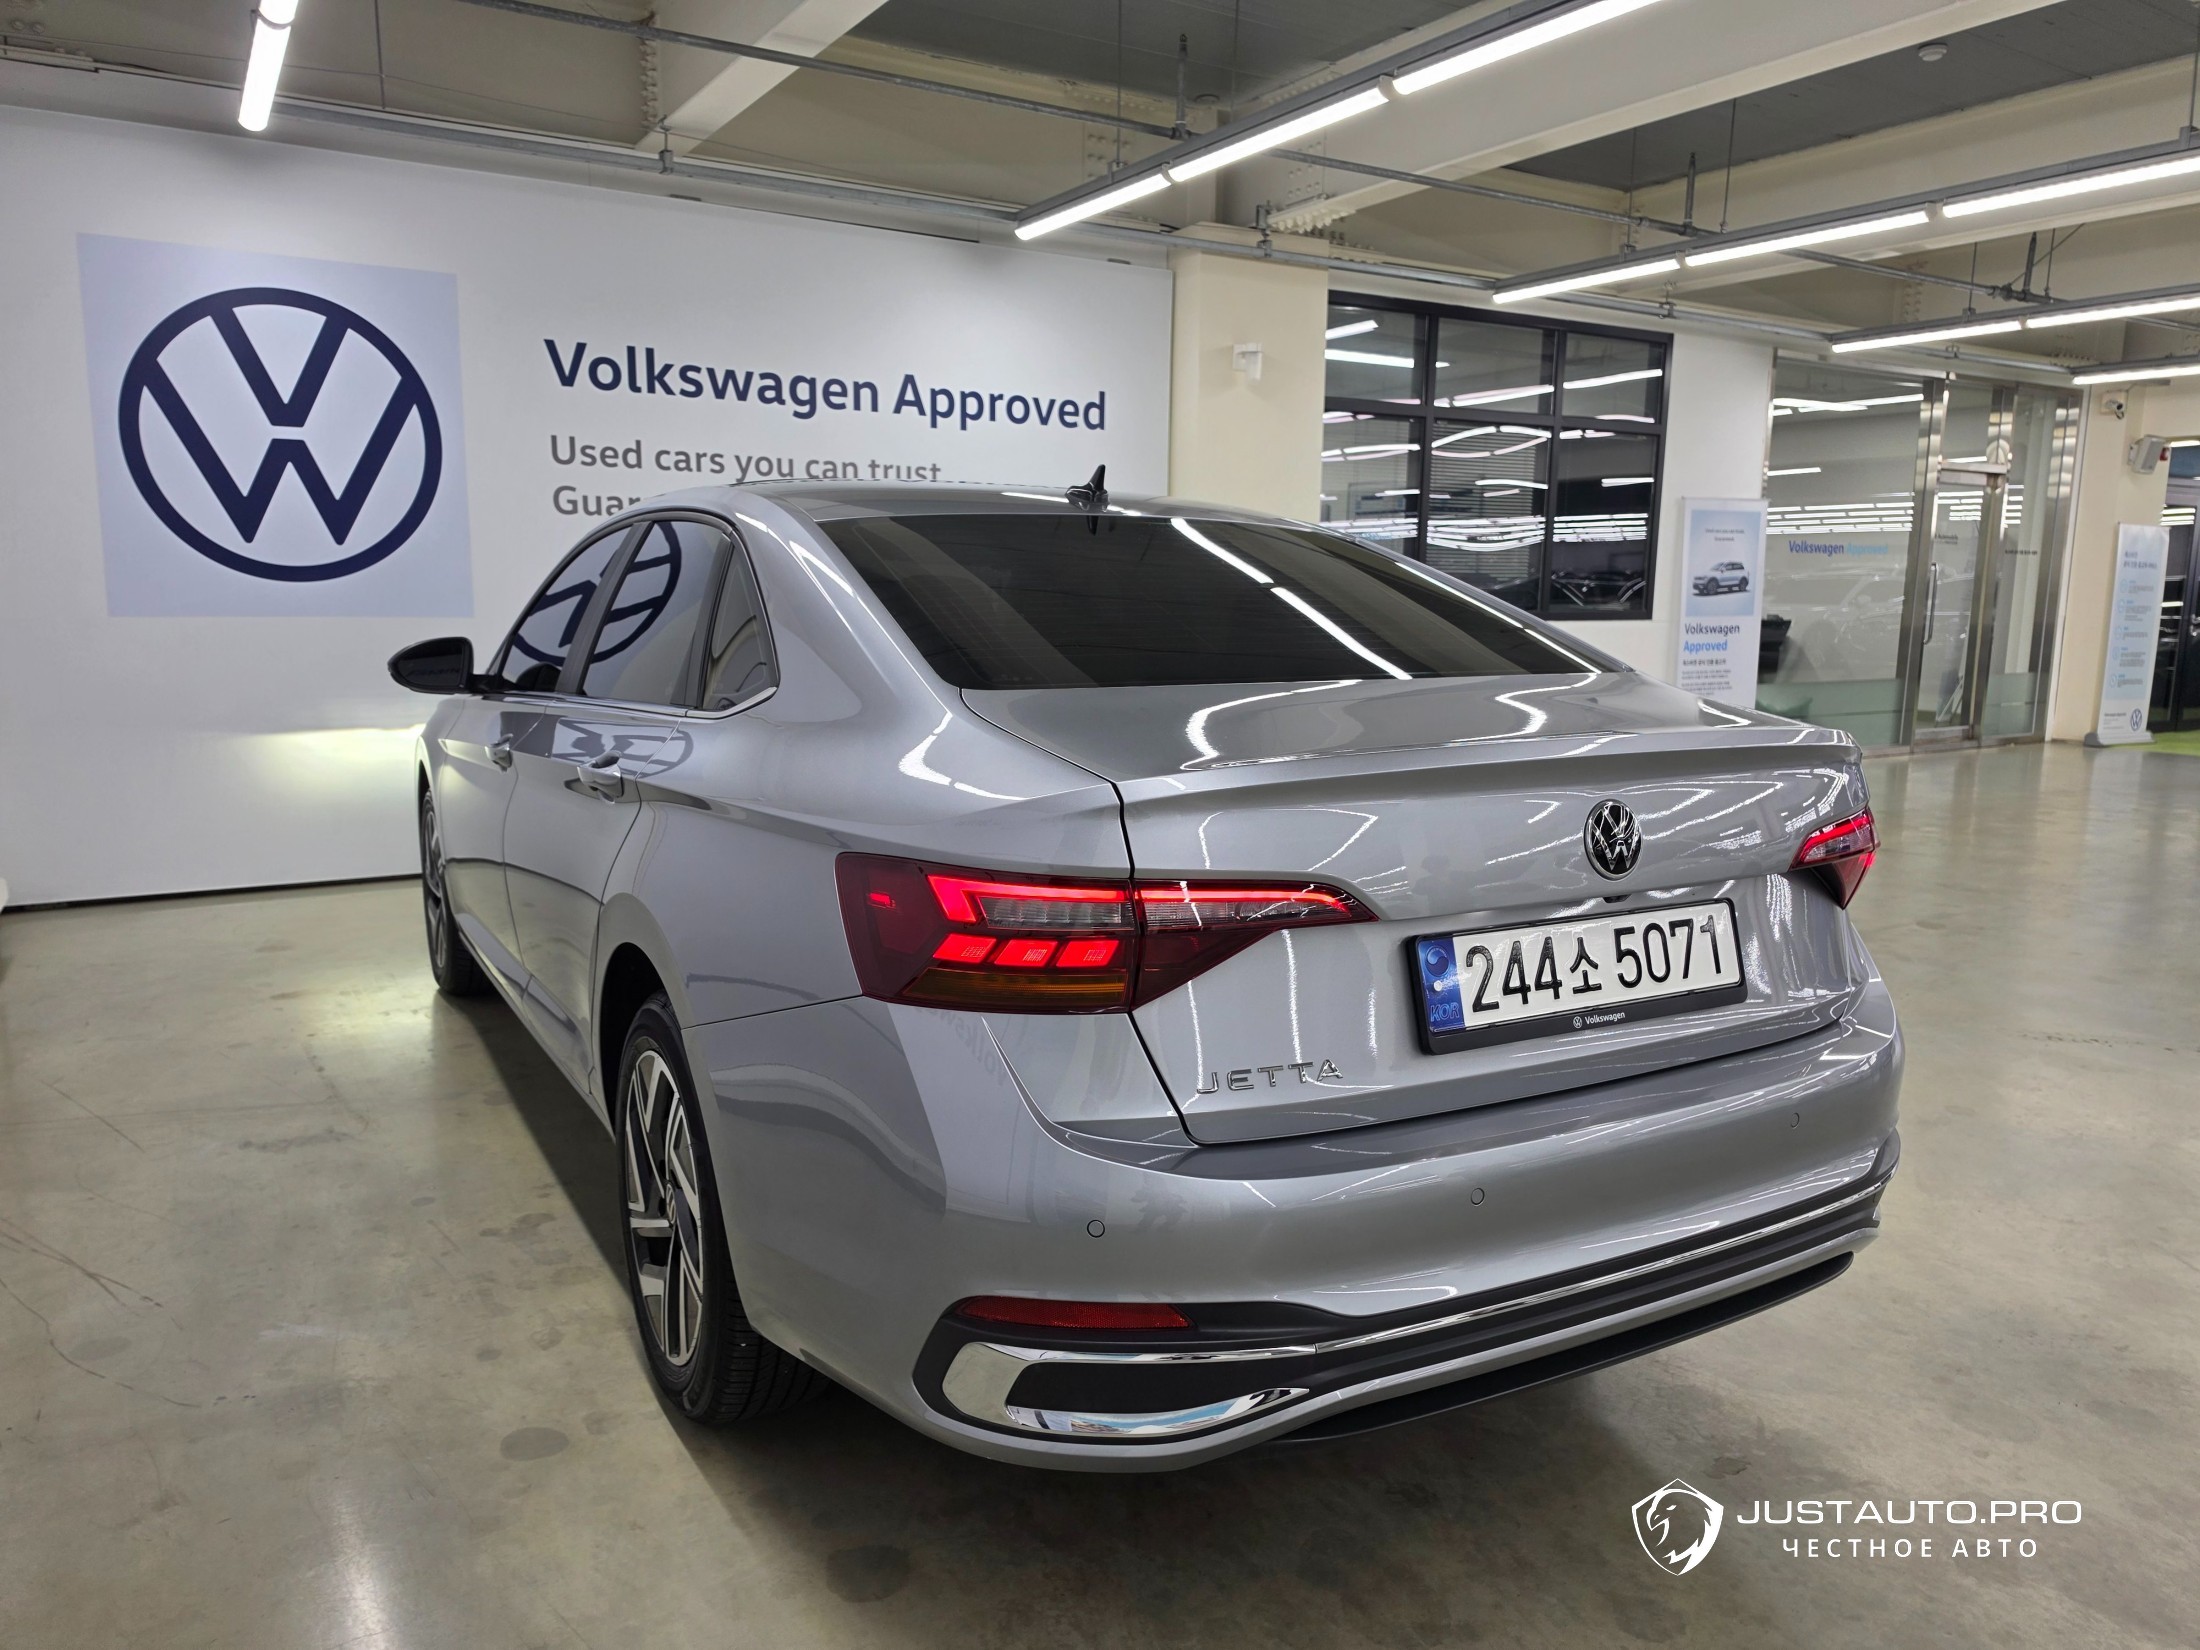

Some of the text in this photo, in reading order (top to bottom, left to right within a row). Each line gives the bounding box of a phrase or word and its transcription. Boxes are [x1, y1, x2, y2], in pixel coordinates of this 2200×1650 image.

[543, 338, 1107, 431] Volkswagen Approved
[550, 435, 942, 484] Used cars you can trust
[1788, 540, 1844, 557] Volkswagen
[1684, 622, 1740, 637] Volkswagen
[1683, 639, 1728, 654] Approved
[1465, 914, 1722, 1013] 244소 5071
[1430, 1002, 1460, 1022] KOR
[1584, 1011, 1626, 1025] Volkswagen
[1196, 1058, 1344, 1094] JETTA
